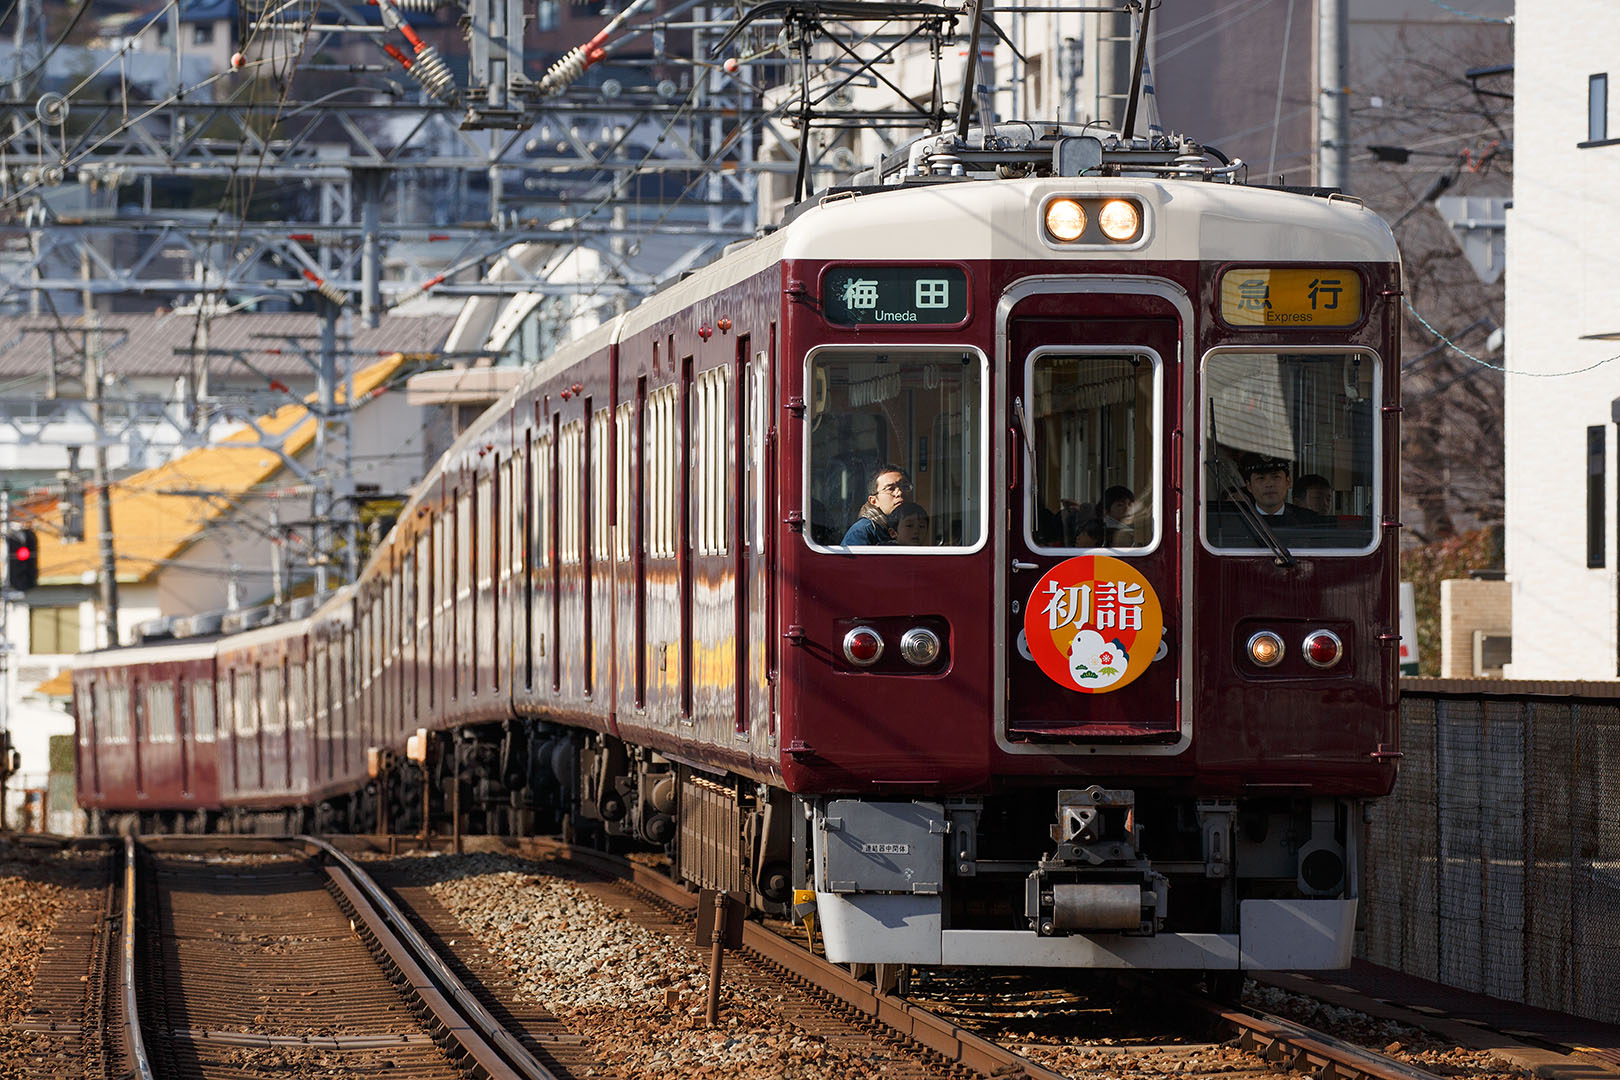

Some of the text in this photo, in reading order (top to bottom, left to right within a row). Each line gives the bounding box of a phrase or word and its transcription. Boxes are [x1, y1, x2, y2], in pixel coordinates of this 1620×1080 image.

[842, 278, 949, 310] 梅田
[1237, 278, 1343, 310] 急行
[875, 310, 918, 322] Umeda
[1266, 310, 1313, 324] Express
[1041, 580, 1145, 631] 初詣
